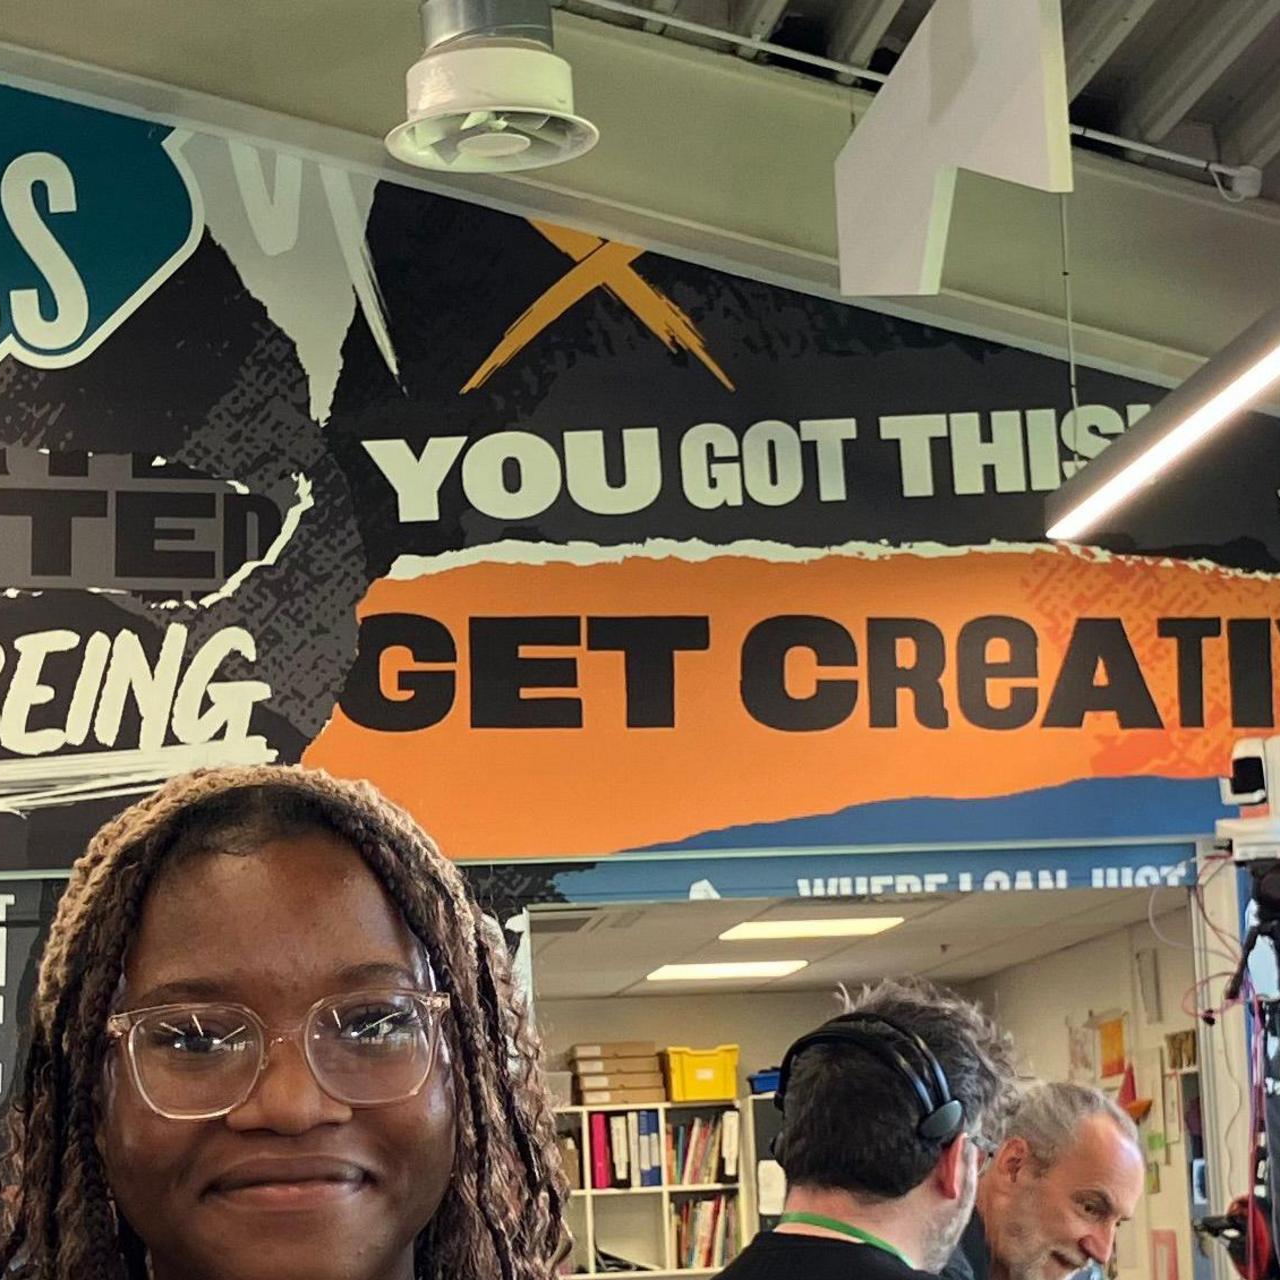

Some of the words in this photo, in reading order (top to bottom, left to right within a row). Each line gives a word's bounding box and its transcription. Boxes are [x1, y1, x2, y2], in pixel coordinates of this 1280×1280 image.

[361, 427, 662, 523] YOU
[680, 418, 858, 510] GOT
[337, 612, 710, 733] GET
